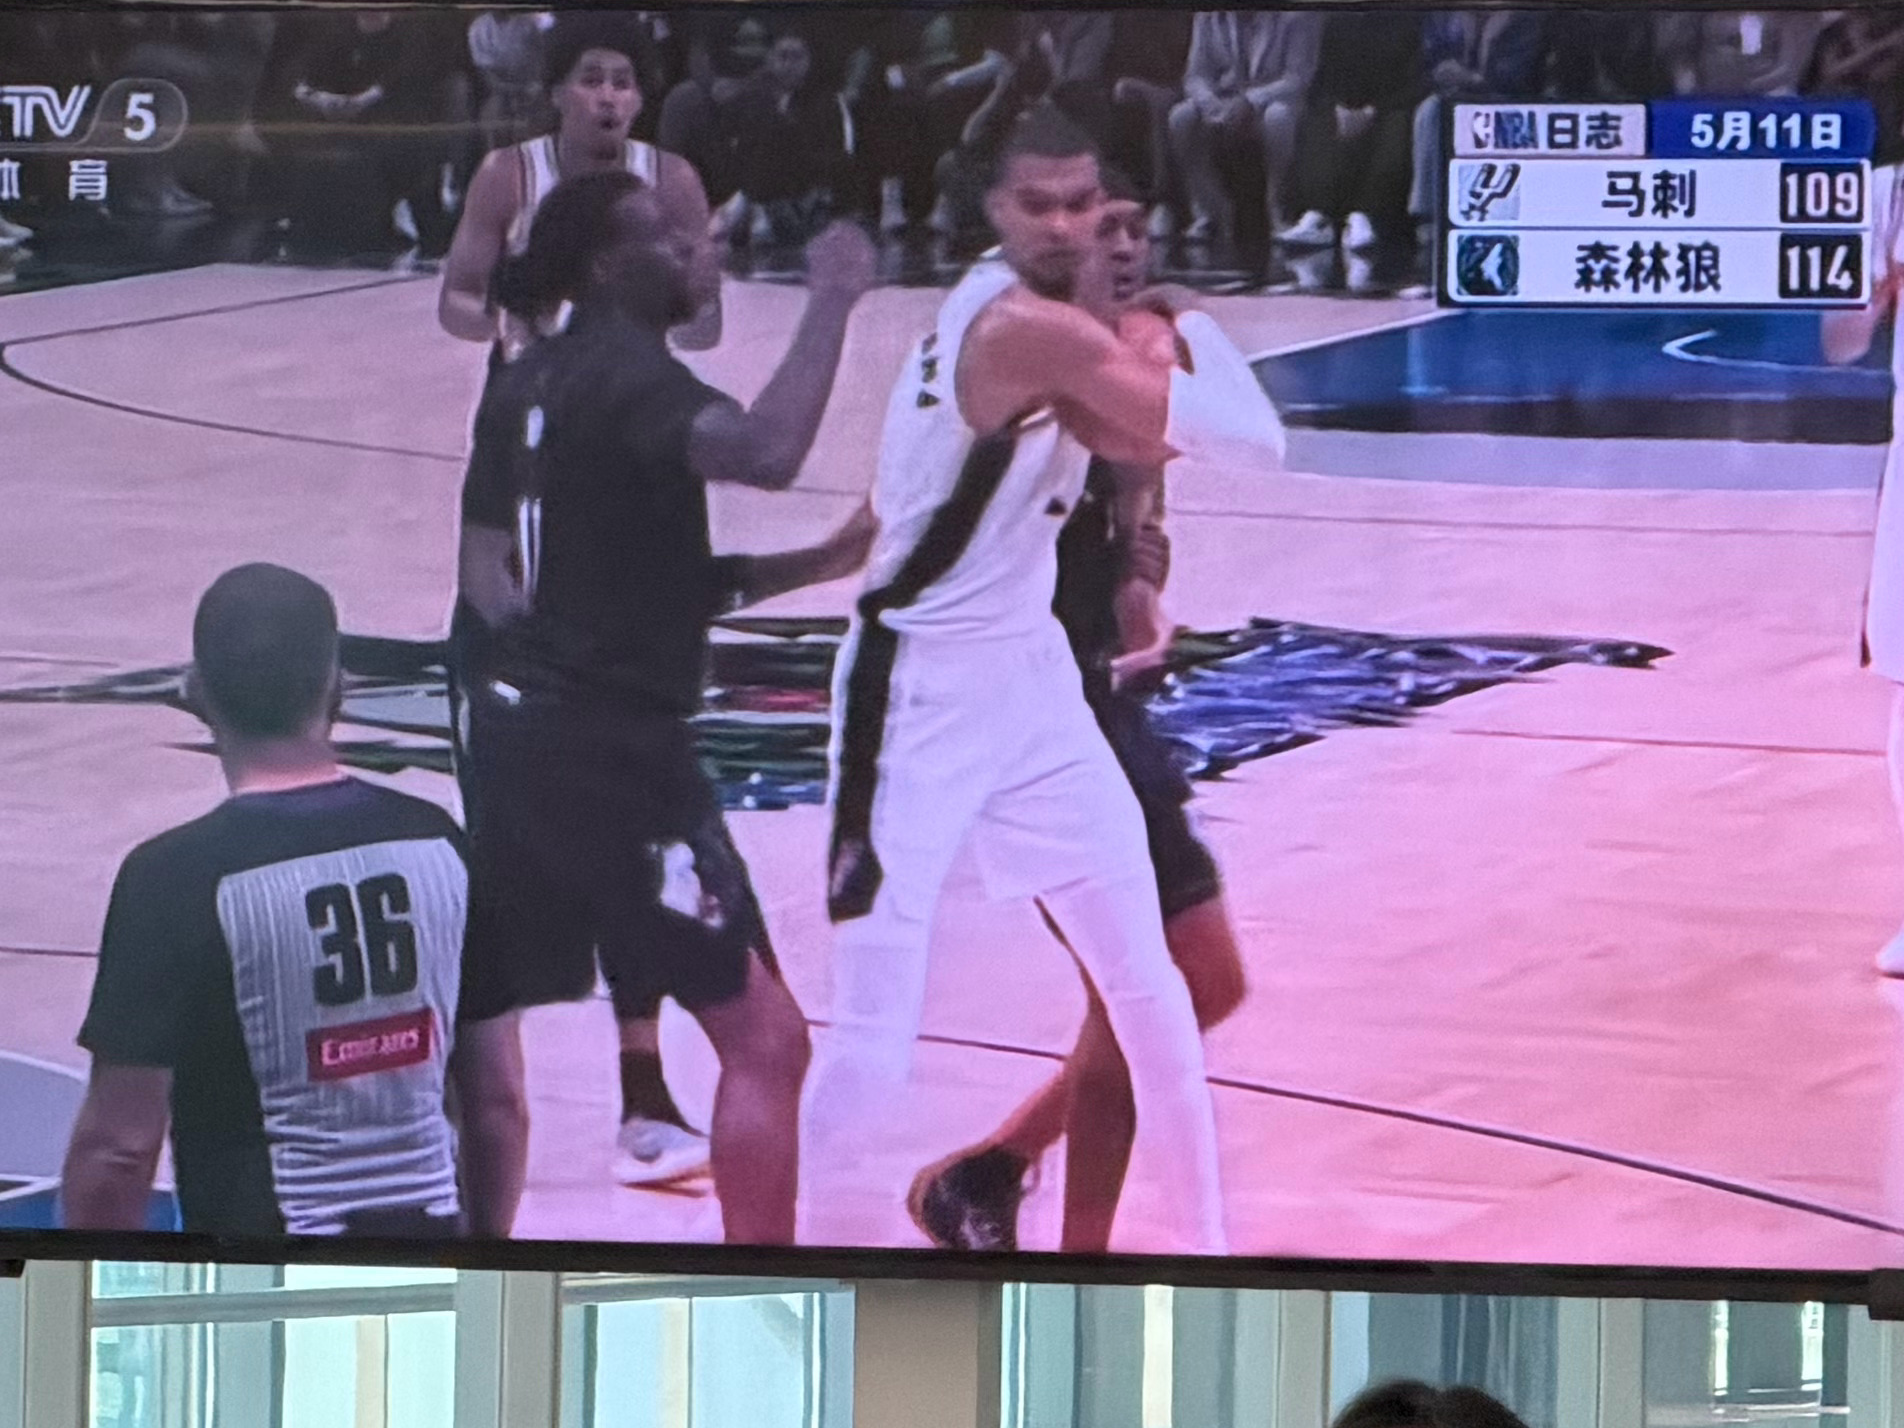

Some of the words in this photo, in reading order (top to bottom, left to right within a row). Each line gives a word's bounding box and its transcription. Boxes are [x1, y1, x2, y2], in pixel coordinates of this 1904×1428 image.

[123, 92, 157, 142] 5
[1691, 112, 1843, 151] 5月11日
[1601, 169, 1698, 220] 马刺
[1784, 170, 1861, 219] 109
[1574, 241, 1723, 295] 森林狼
[1784, 244, 1854, 292] 114
[305, 872, 418, 1007] 36
